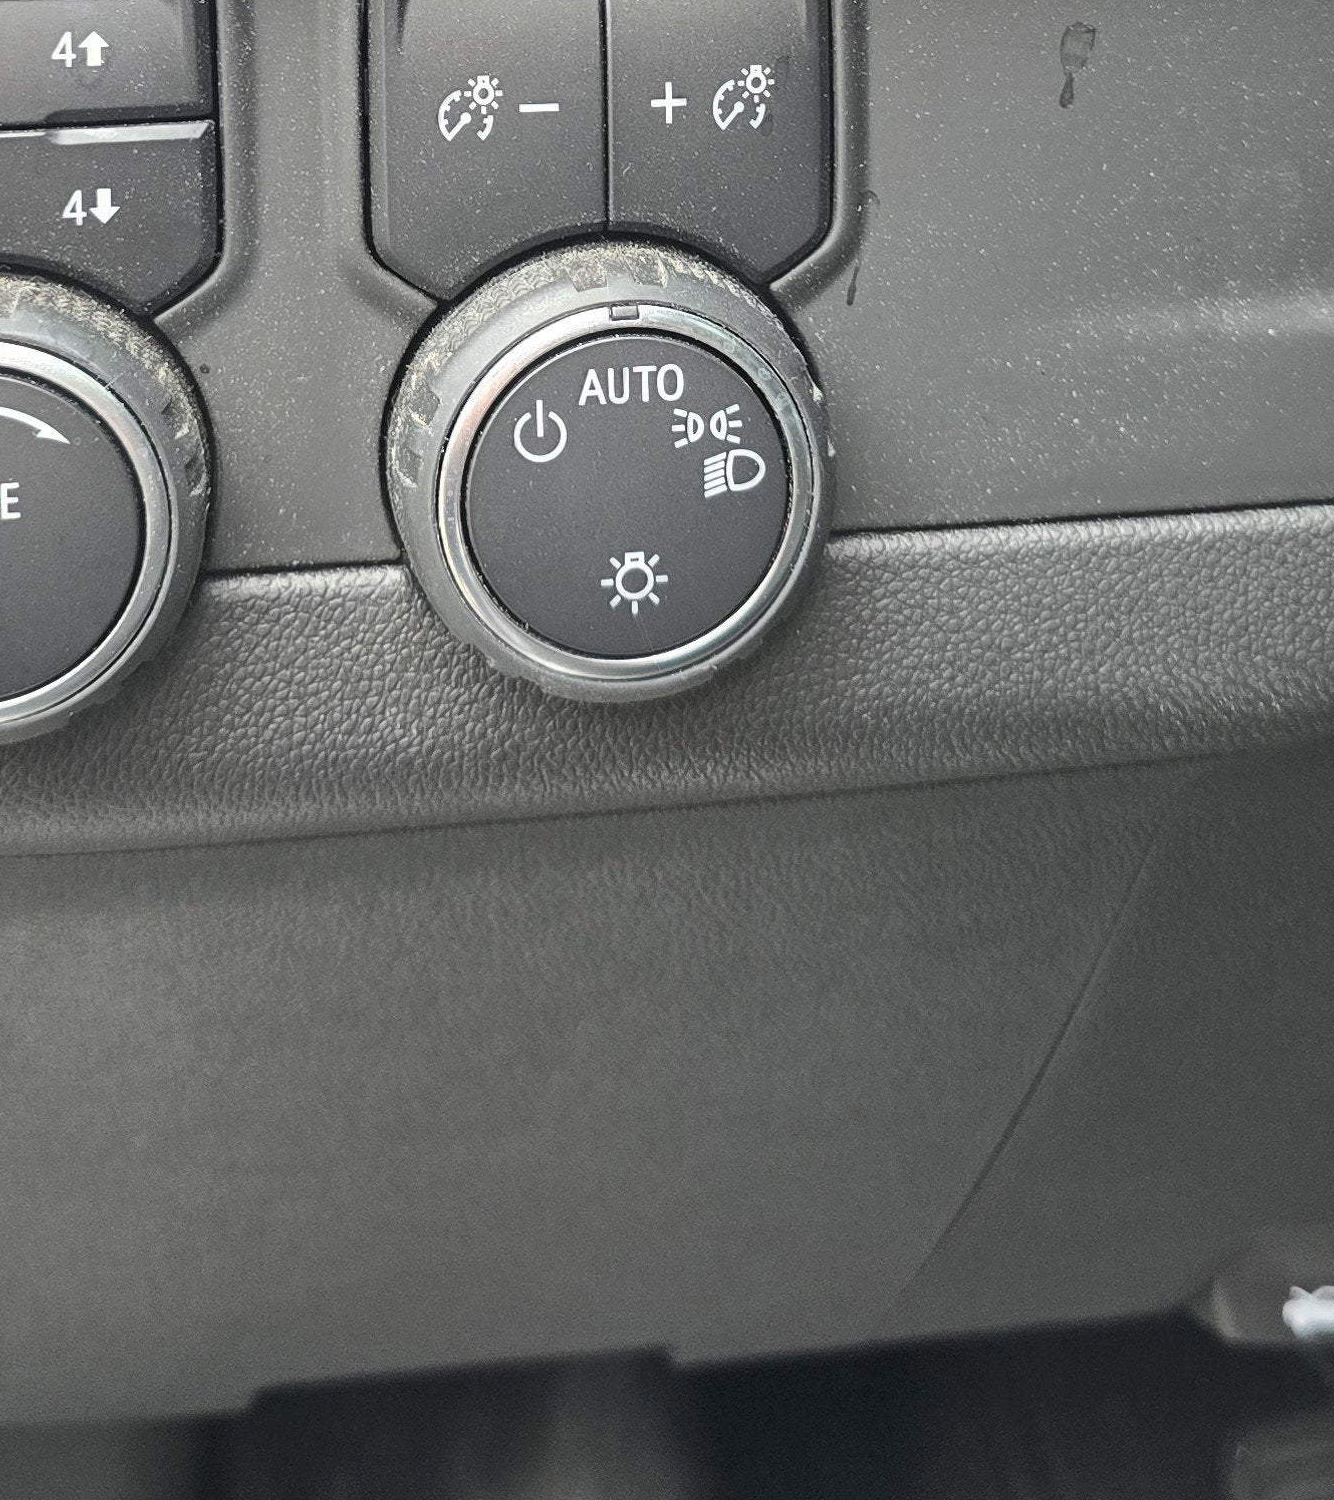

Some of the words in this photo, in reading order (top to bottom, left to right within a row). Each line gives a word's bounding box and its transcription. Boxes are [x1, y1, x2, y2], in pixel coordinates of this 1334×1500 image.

[50, 31, 78, 68] 4
[61, 190, 88, 226] 4
[578, 363, 685, 406] AUTO
